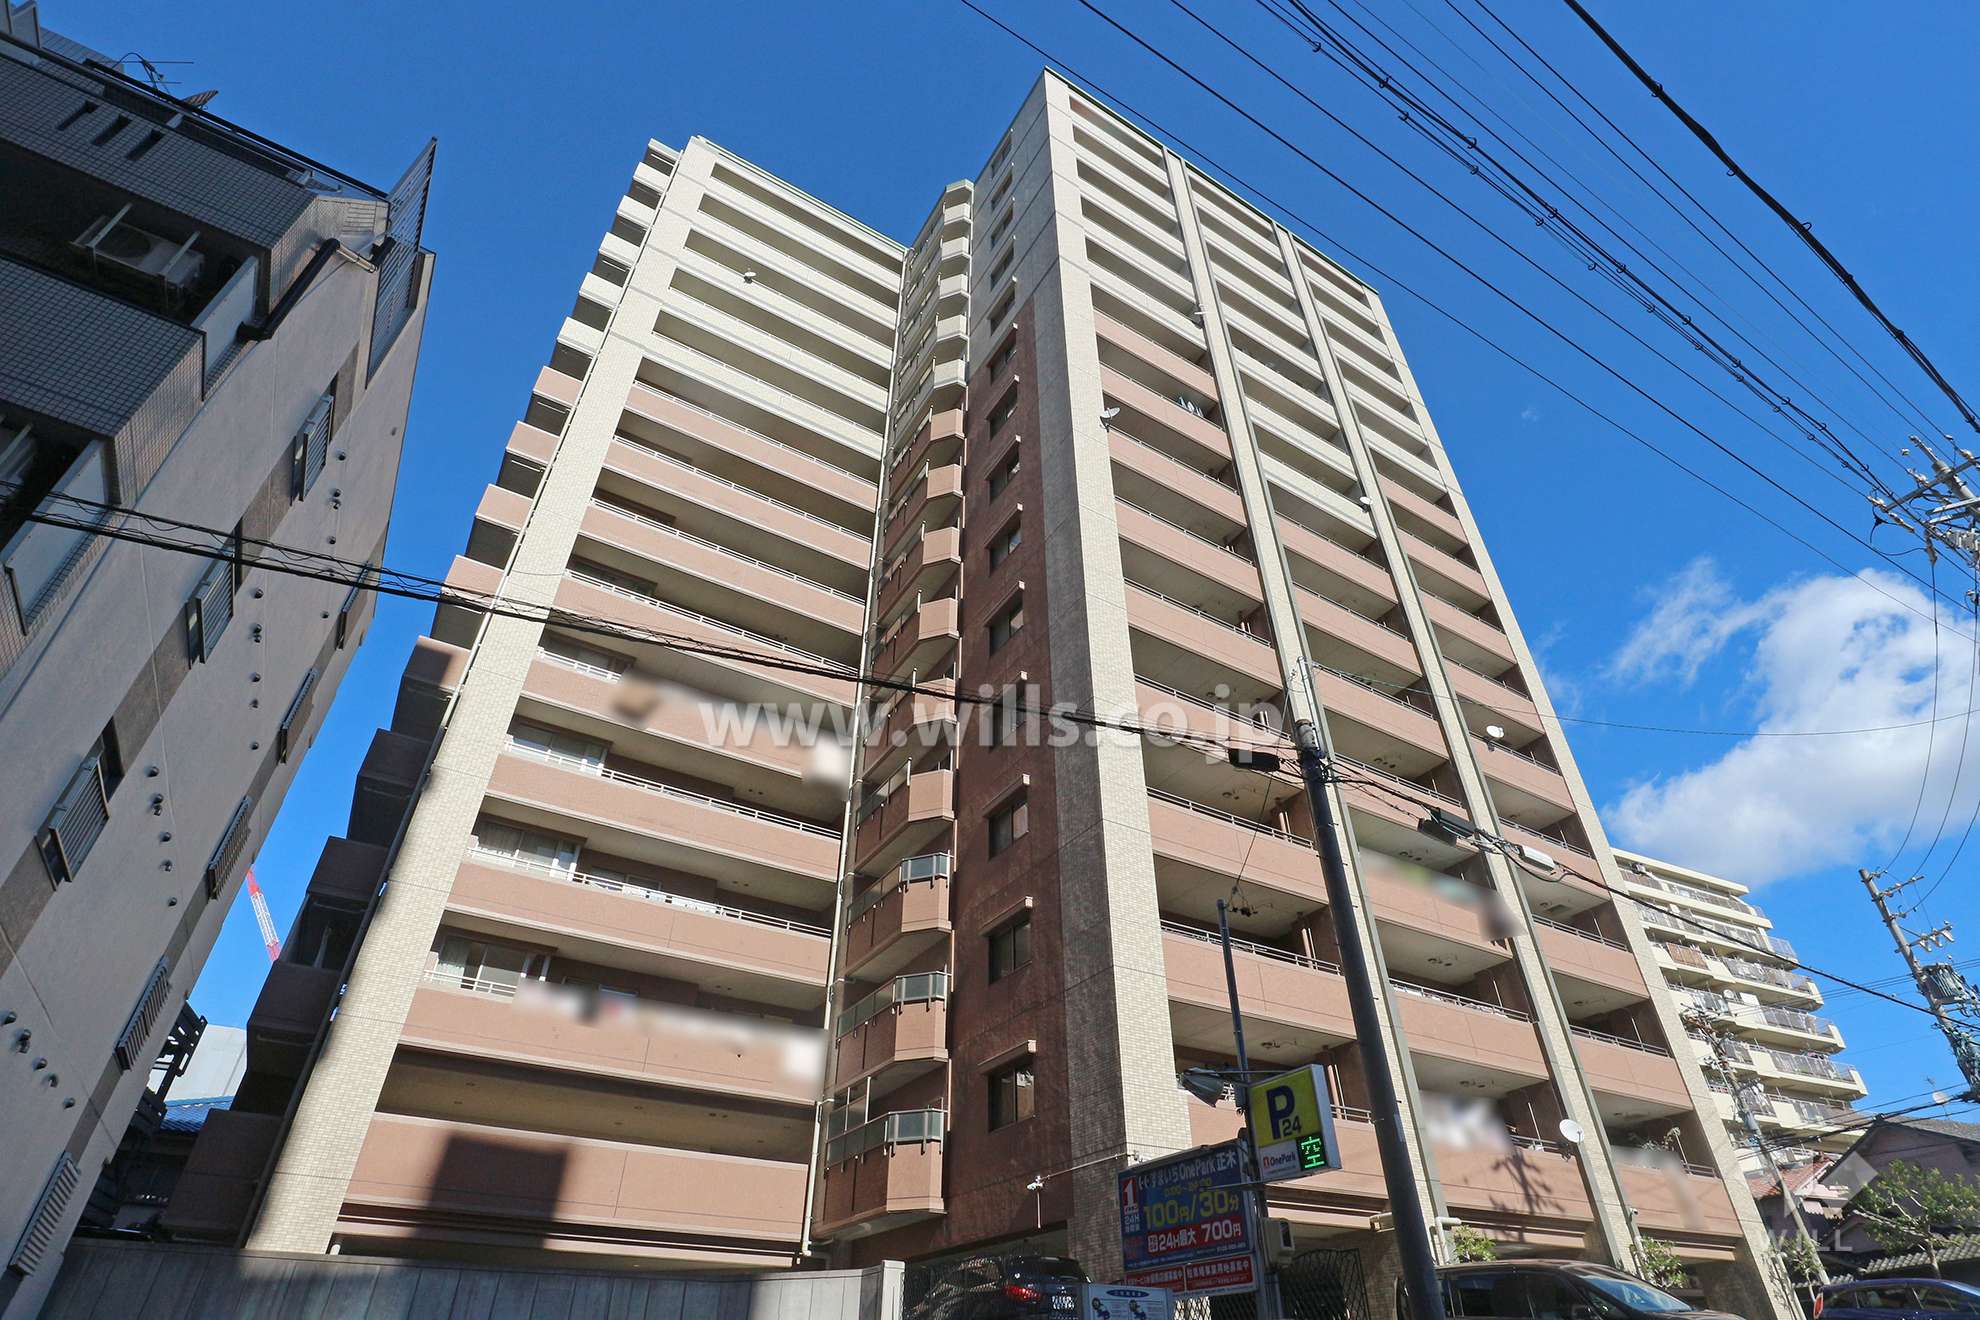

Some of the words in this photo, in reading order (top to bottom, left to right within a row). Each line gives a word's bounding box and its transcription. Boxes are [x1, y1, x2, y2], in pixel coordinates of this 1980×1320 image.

[1267, 1085, 1295, 1140] P
[1281, 1115, 1302, 1137] 24
[1301, 1136, 1325, 1169] 空
